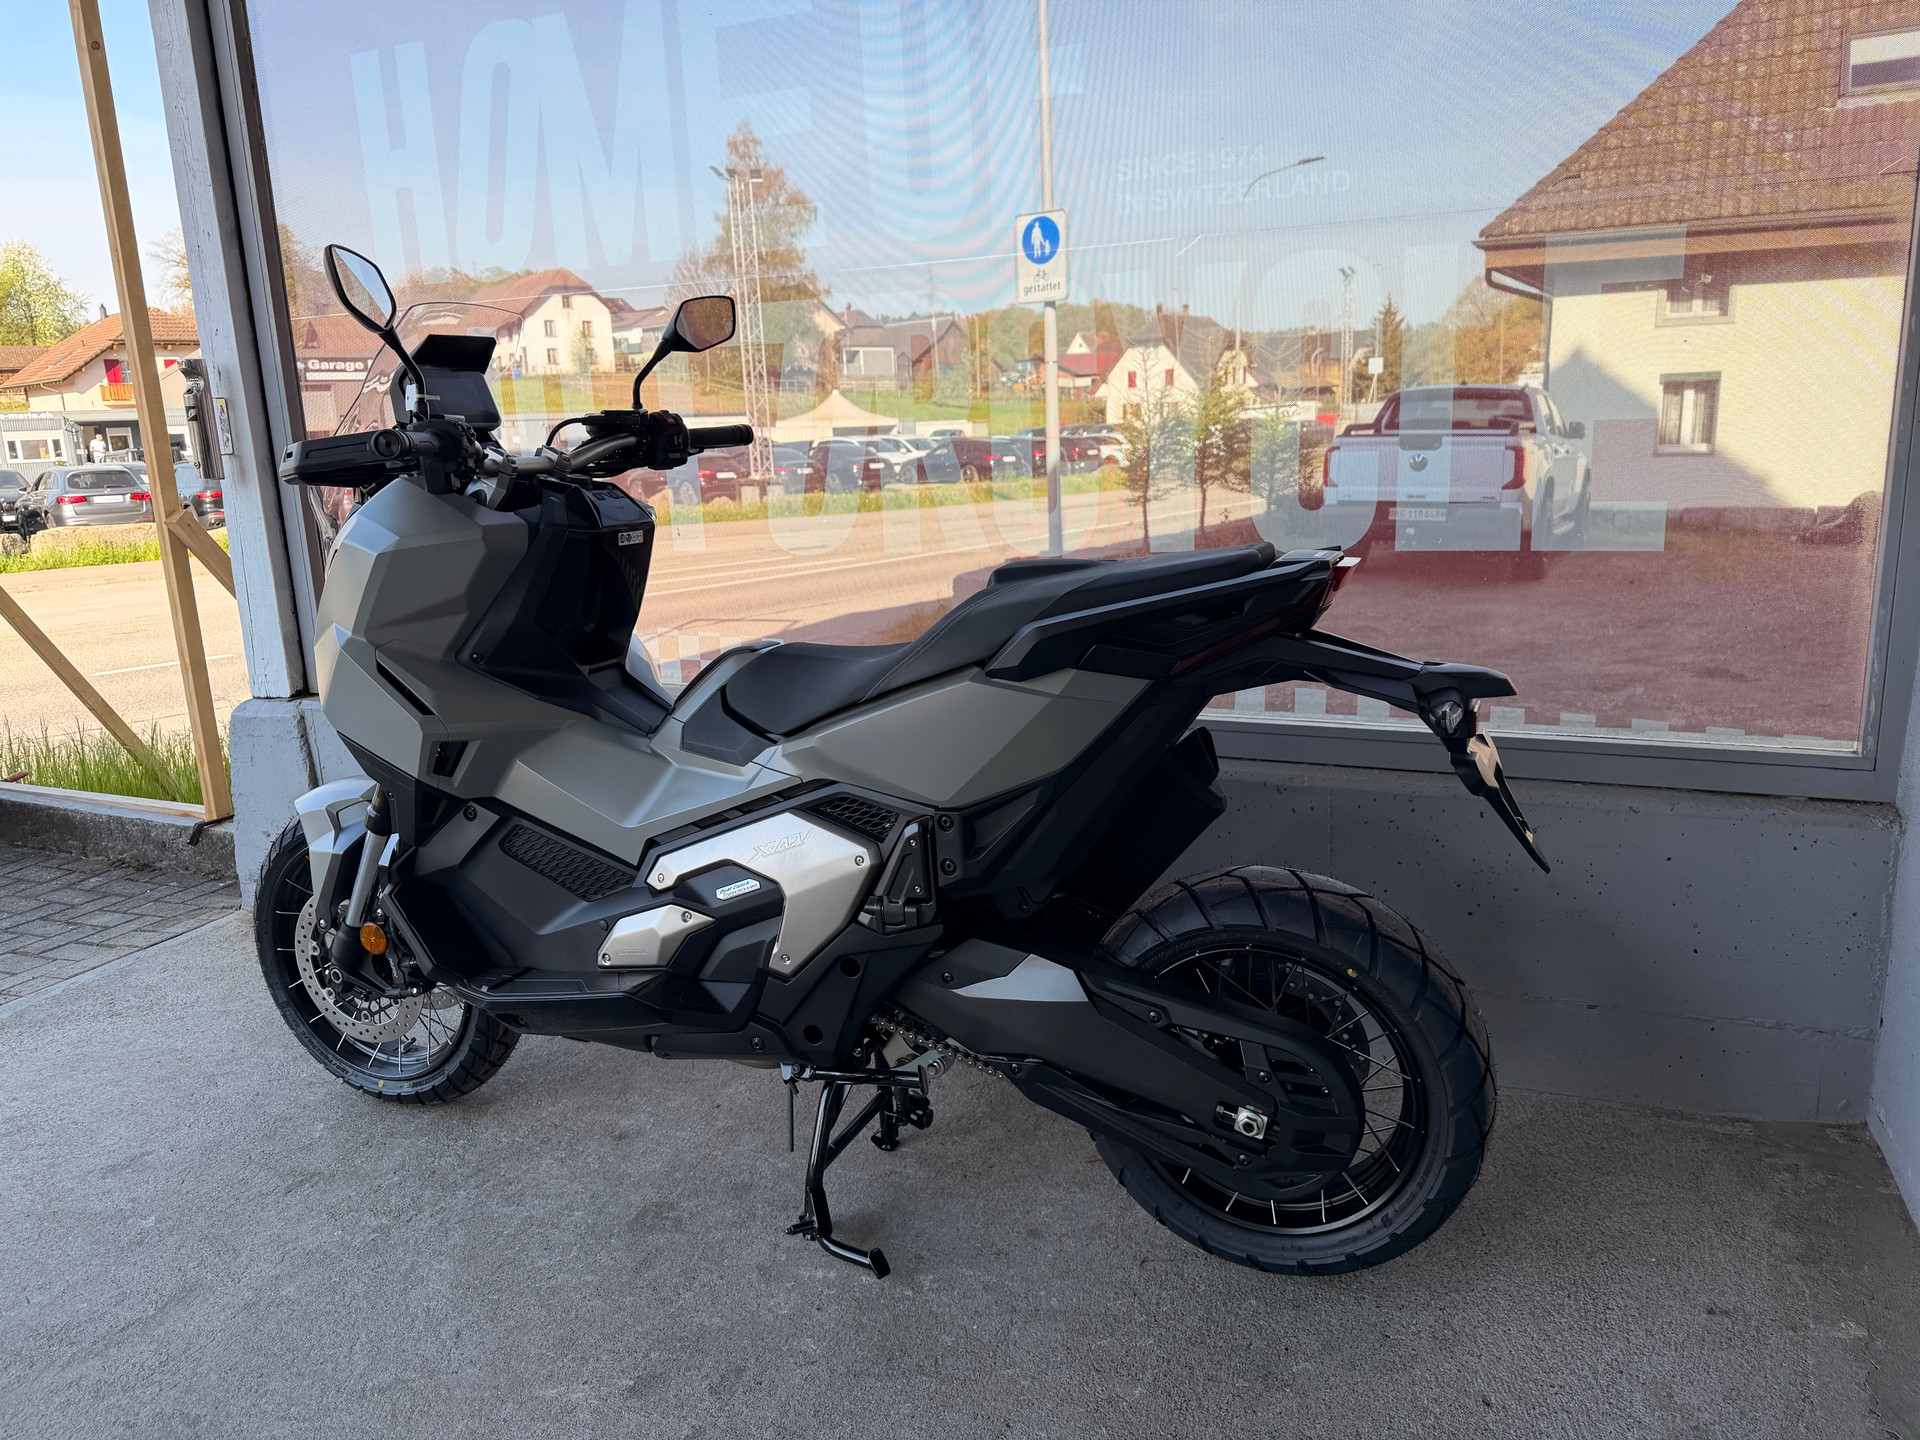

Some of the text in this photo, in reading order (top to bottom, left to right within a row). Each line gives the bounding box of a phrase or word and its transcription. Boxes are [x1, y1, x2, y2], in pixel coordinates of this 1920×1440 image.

[350, 0, 826, 282] HOME
[1117, 143, 1266, 181] SINCE 1974
[1117, 170, 1352, 214] IN SWITZERLAND
[1023, 281, 1062, 296] gestattet
[307, 359, 364, 371] Garage
